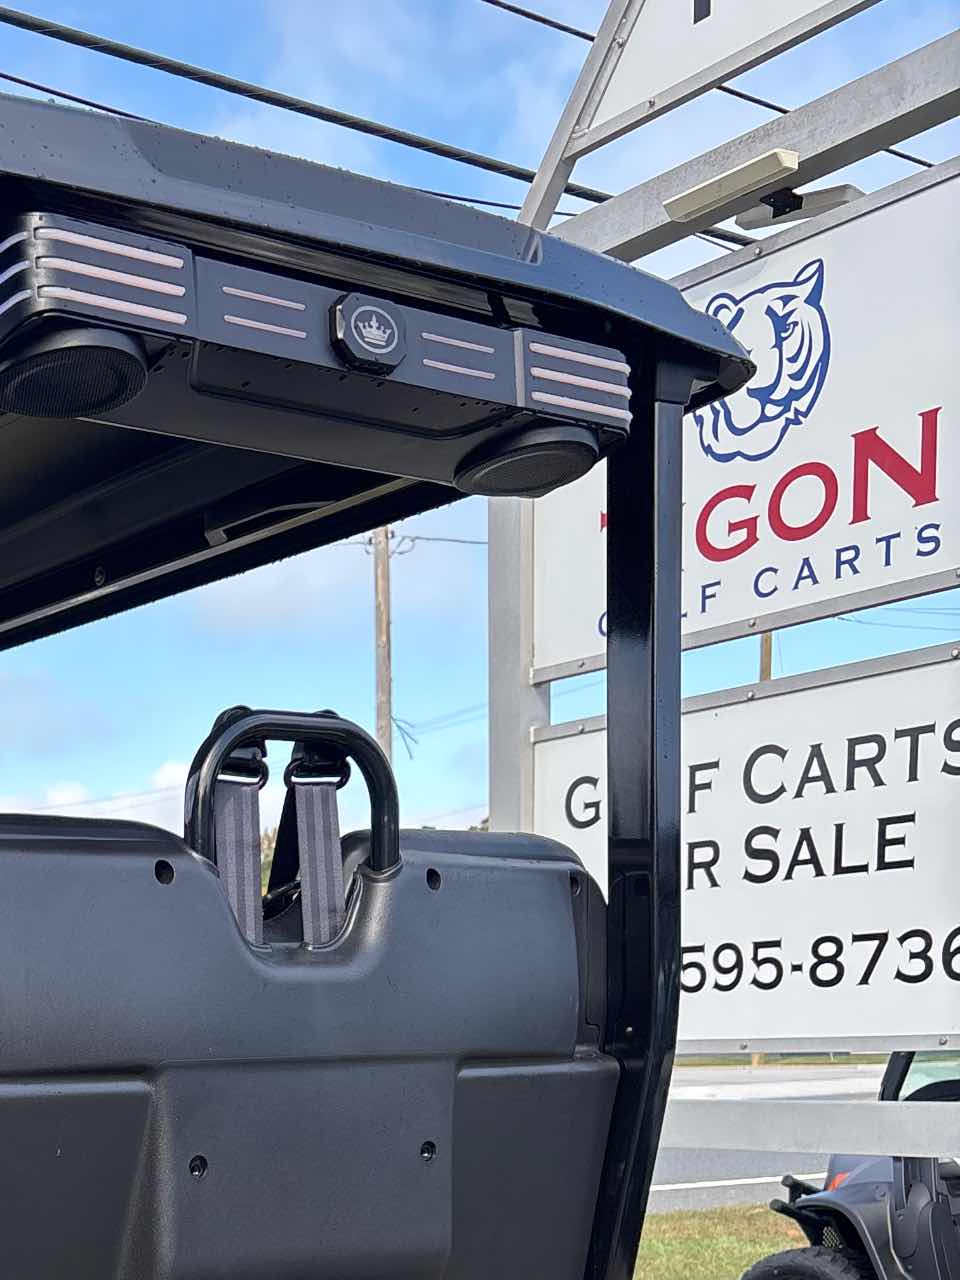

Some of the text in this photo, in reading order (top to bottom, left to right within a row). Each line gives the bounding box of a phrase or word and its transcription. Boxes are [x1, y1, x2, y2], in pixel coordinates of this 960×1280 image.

[600, 407, 942, 563] GON
[753, 523, 942, 599] CARTS
[565, 718, 960, 829] GF CARTS
[742, 811, 916, 884] SALE
